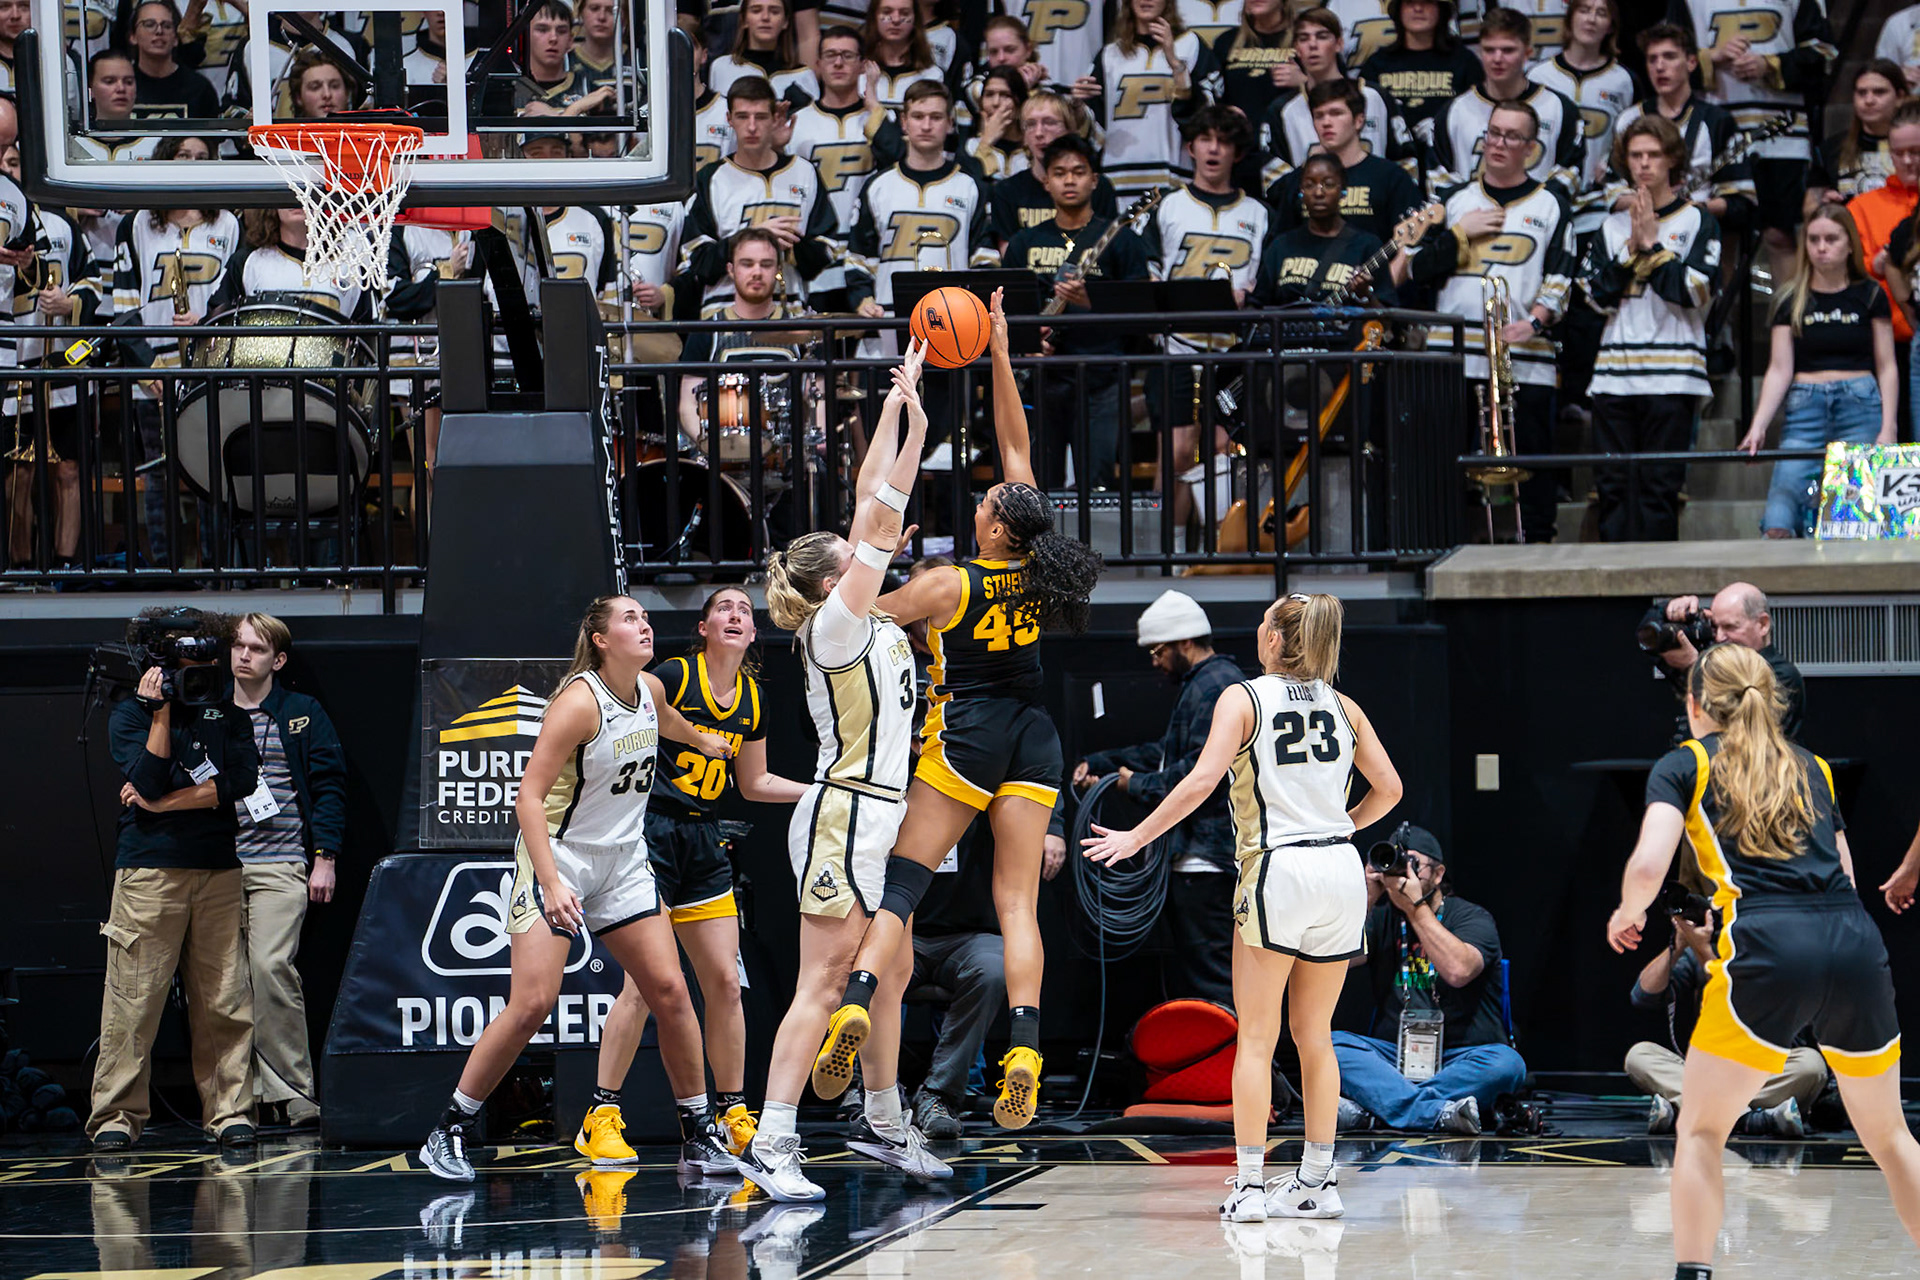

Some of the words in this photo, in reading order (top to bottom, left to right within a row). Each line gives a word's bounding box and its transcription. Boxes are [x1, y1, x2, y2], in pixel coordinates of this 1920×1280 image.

[1113, 73, 1175, 121] P
[1379, 71, 1454, 90] PURDUE
[880, 211, 960, 263] P
[1170, 233, 1252, 281] P
[1281, 257, 1355, 285] PURUE
[973, 601, 1041, 652] 45
[1286, 685, 1314, 702] ELLIS
[1272, 710, 1341, 766] 23
[438, 750, 535, 778] PURD
[610, 755, 655, 796] 33
[671, 751, 726, 800] 20
[438, 781, 521, 807] FEDE
[437, 810, 512, 824] CREDIT
